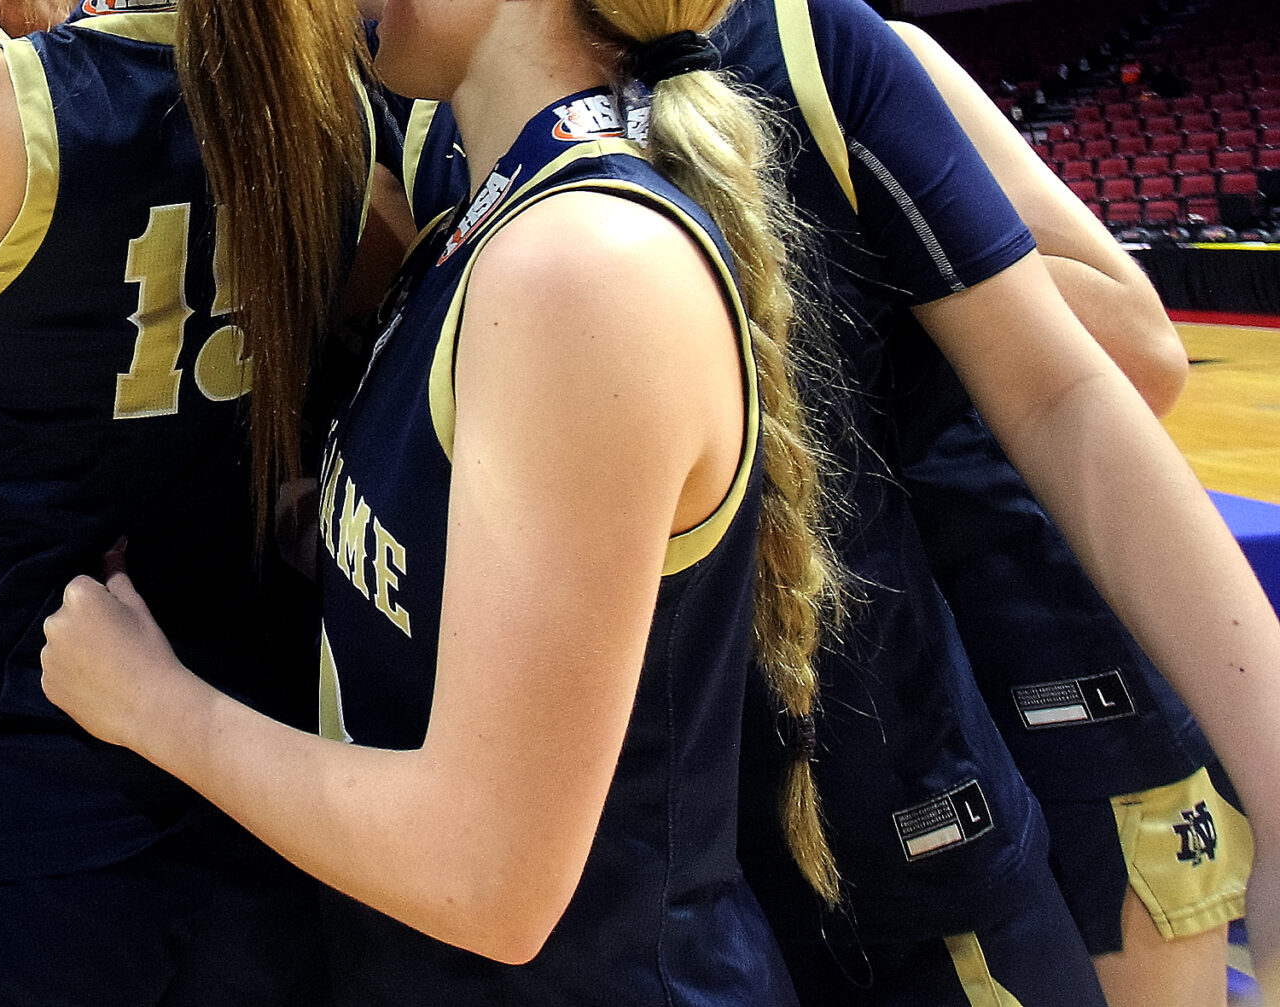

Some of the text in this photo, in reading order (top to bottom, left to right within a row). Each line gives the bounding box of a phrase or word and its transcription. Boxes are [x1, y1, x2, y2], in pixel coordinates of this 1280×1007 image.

[319, 438, 412, 639] AME
[1097, 687, 1117, 708] L
[964, 800, 983, 824] L
